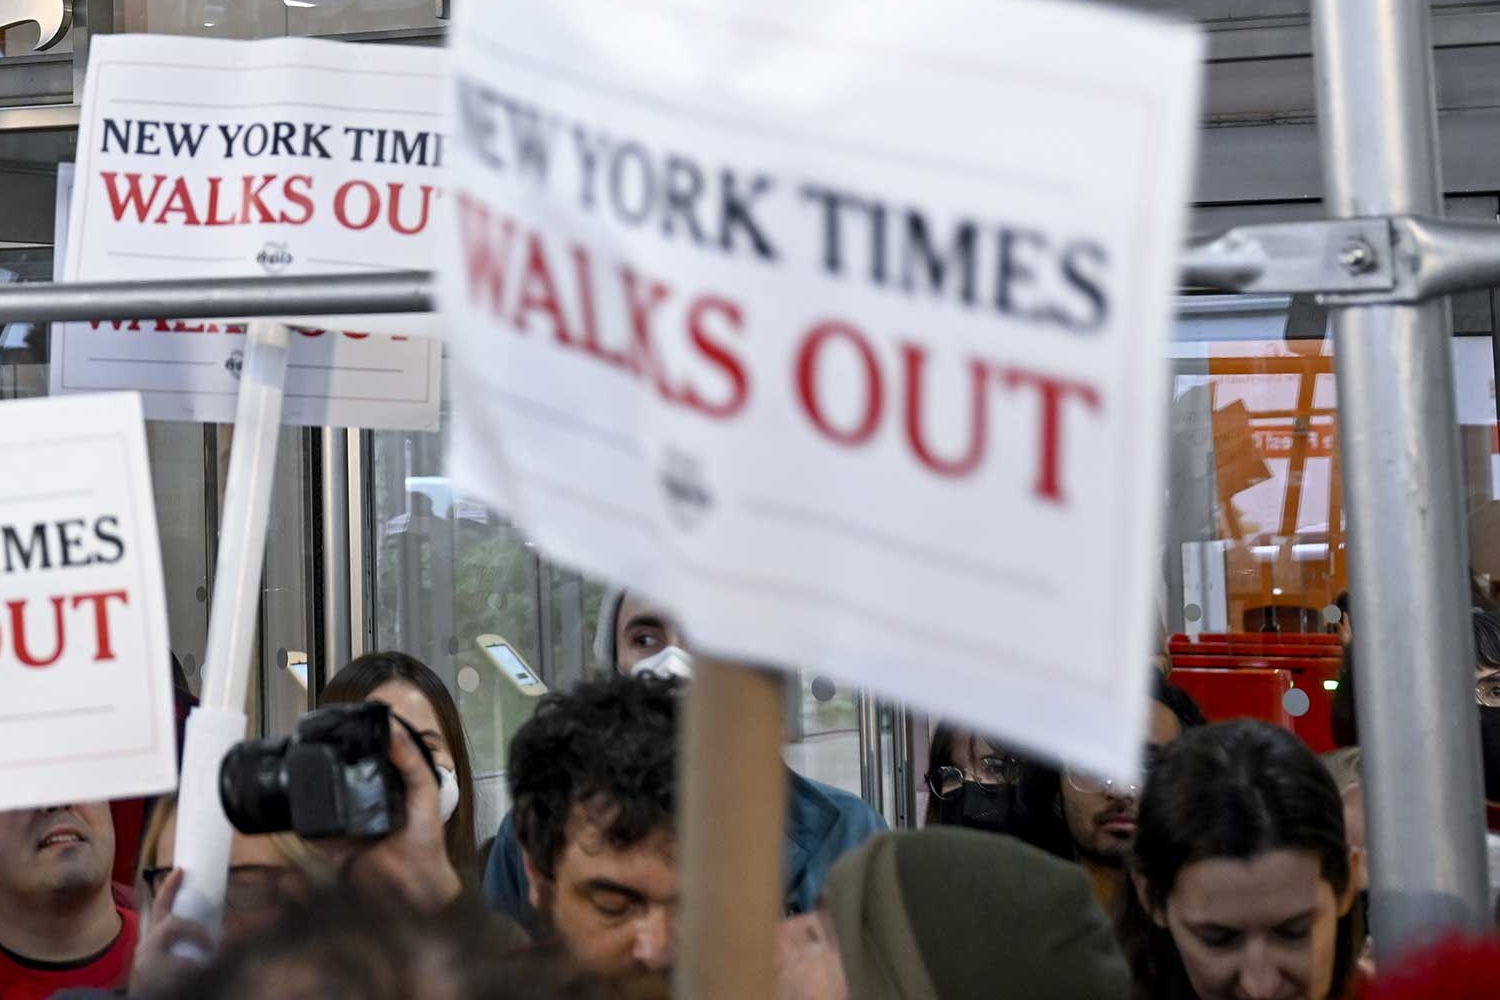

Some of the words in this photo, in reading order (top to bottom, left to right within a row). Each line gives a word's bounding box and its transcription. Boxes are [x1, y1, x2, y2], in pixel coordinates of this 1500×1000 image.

[100, 118, 208, 158] NEW
[218, 122, 332, 159] YORK
[344, 127, 442, 168] TIM
[100, 171, 314, 226] WALKS
[332, 180, 440, 235] OU
[572, 120, 780, 266] YORK
[795, 184, 1112, 336] TIMES
[455, 188, 752, 423] WALKS
[793, 320, 1104, 508] OUT
